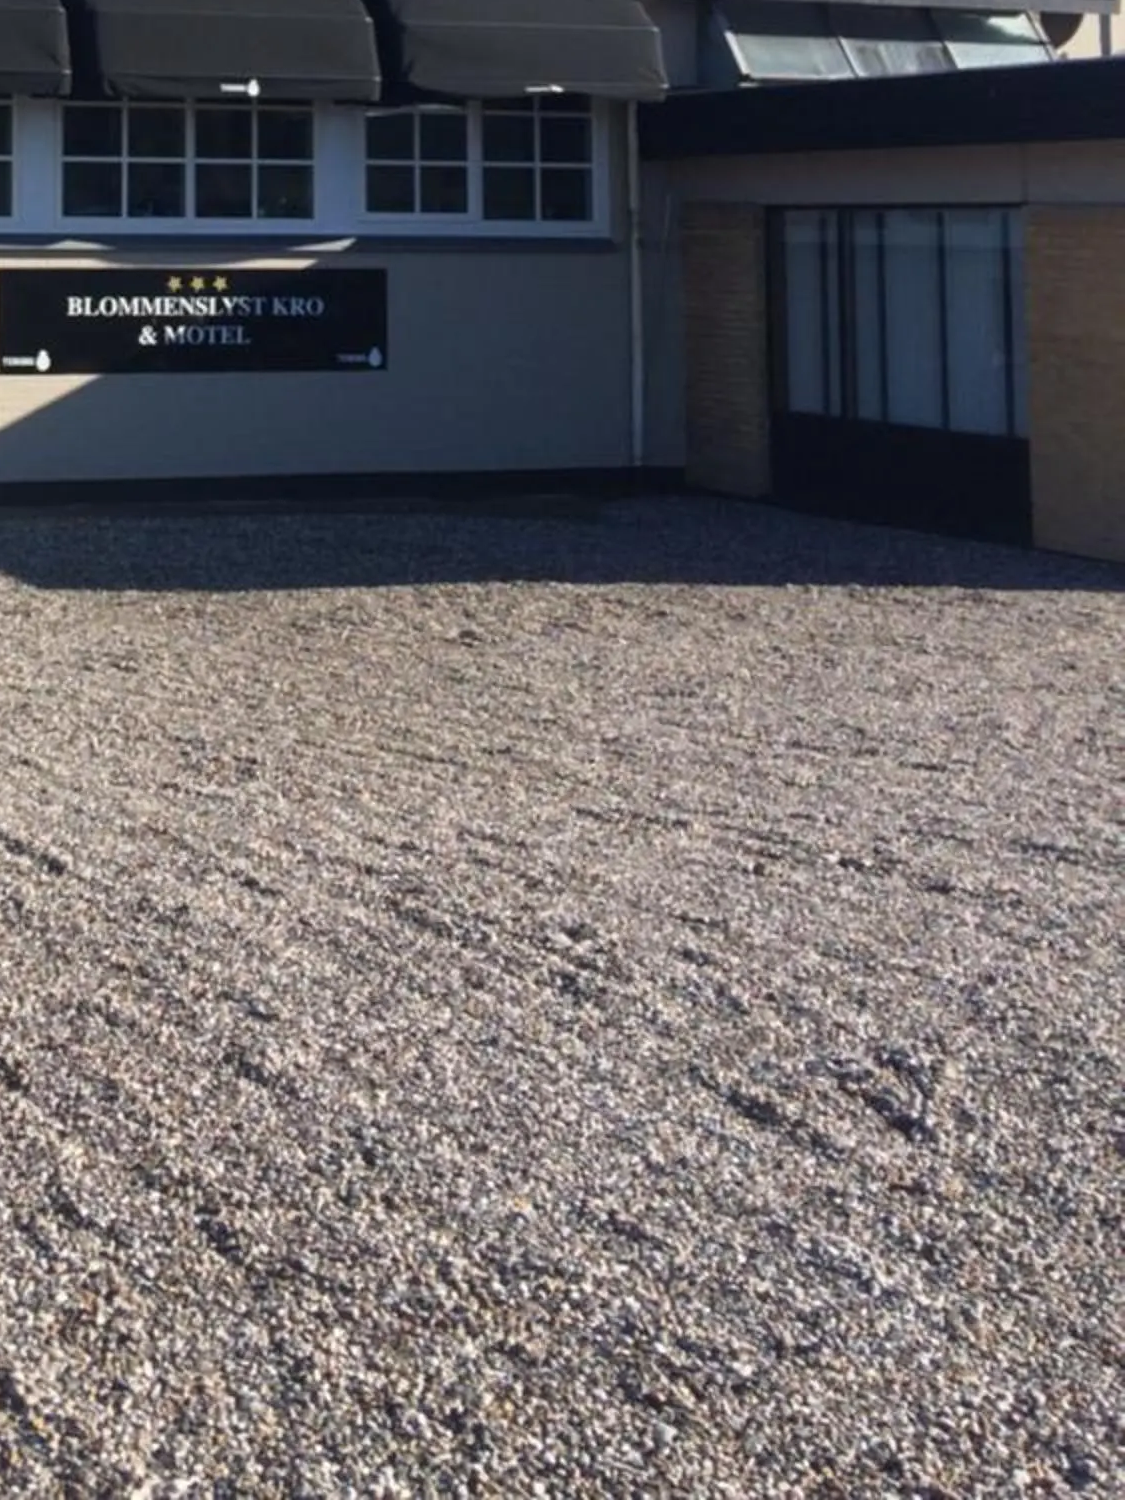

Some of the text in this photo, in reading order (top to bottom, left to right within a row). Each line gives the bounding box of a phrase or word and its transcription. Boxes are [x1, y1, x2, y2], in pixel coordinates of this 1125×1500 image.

[66, 296, 325, 317] BLOMMENSLYST KRO
[137, 324, 252, 346] & MOTEL
